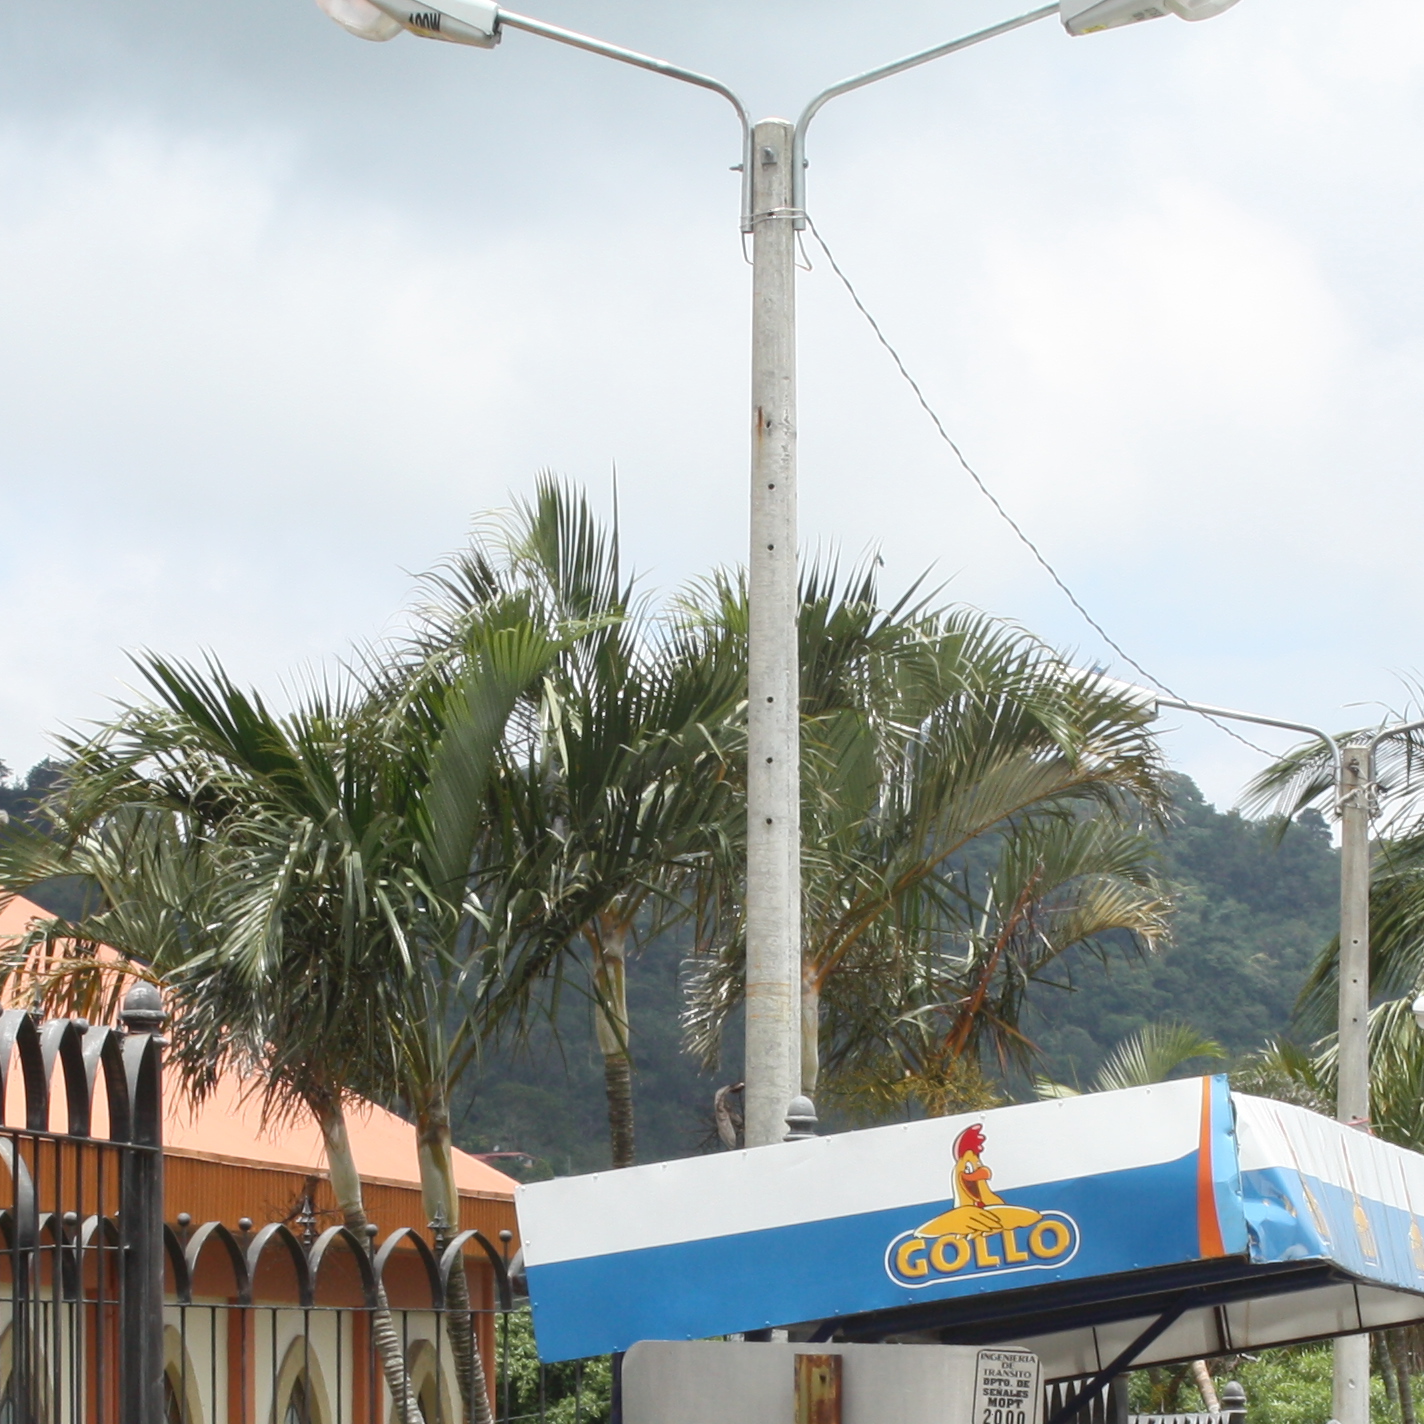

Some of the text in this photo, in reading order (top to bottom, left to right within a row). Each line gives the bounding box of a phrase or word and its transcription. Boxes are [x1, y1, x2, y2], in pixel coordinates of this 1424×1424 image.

[895, 1220, 1071, 1278] GOLLO
[983, 1378, 1030, 1388] DPTO. DE
[987, 1397, 1023, 1409] MOPT
